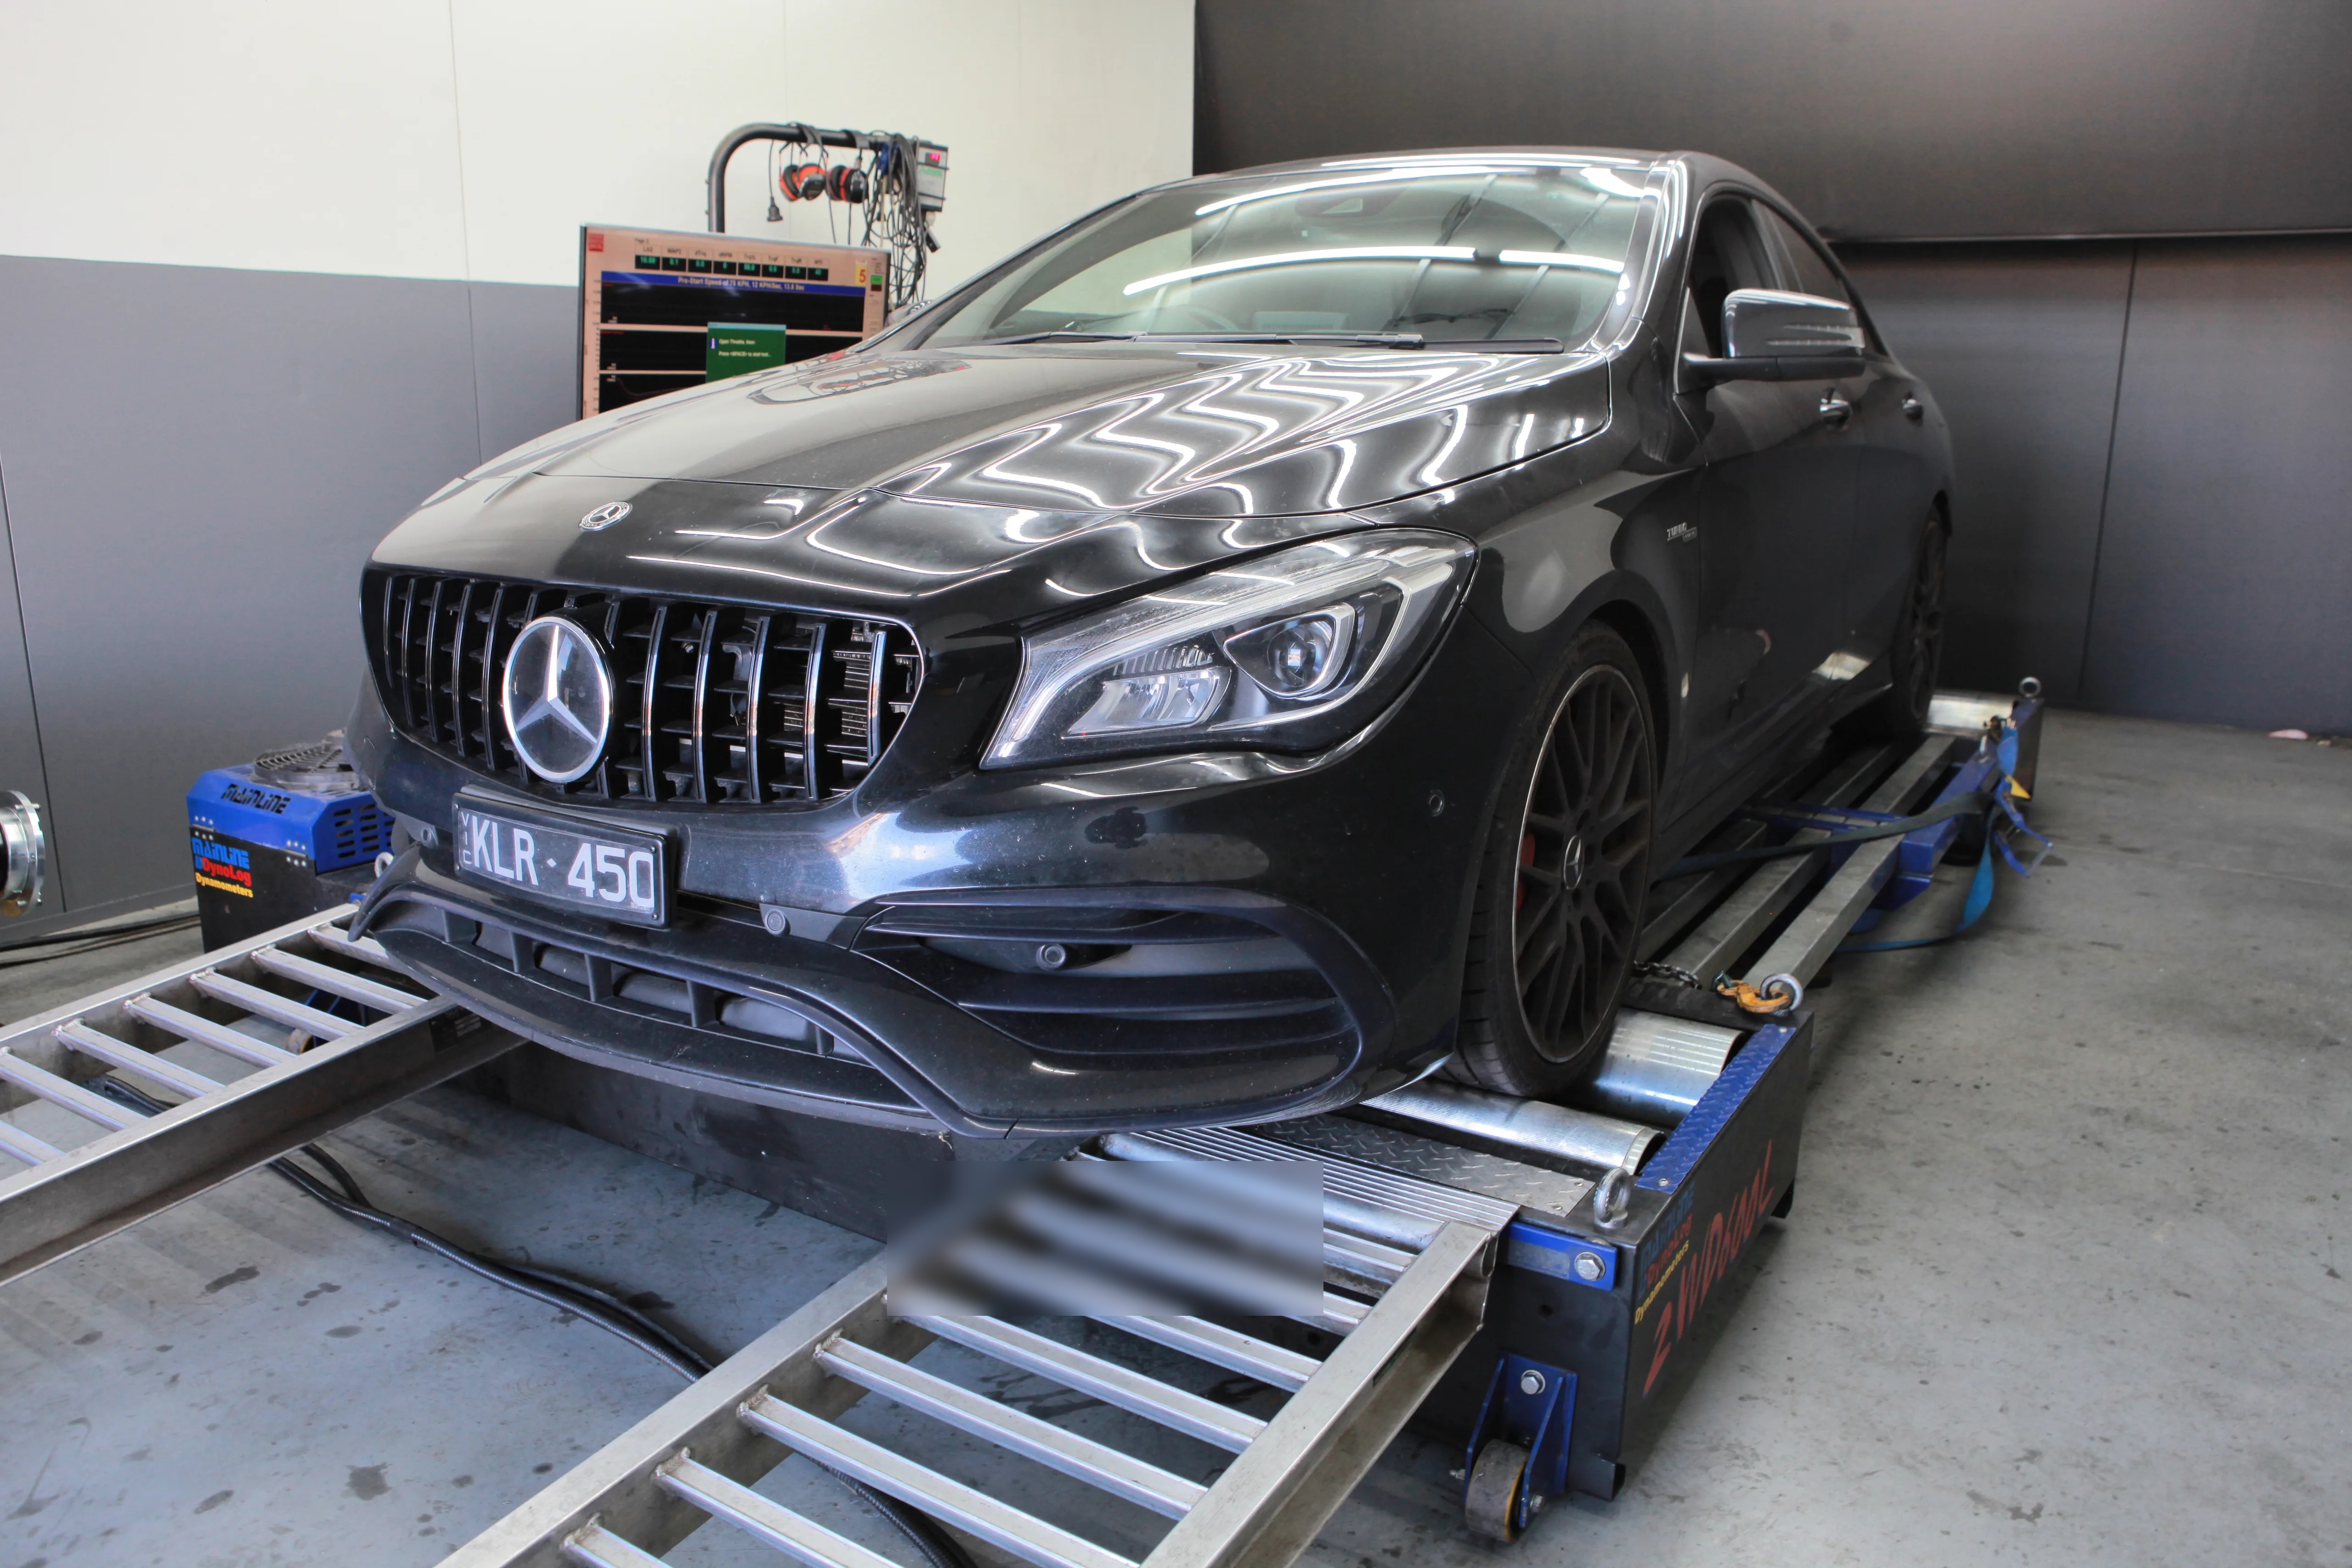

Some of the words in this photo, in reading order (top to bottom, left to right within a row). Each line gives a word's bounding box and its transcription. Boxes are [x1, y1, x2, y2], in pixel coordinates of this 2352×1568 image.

[859, 269, 865, 283] 5
[192, 837, 250, 869] MAINLINE
[461, 811, 472, 865] VIC
[195, 872, 253, 898] Dynamometers
[202, 856, 252, 887] DynoLog
[568, 843, 655, 908] 450
[1635, 1240, 1689, 1325] Dynamometers
